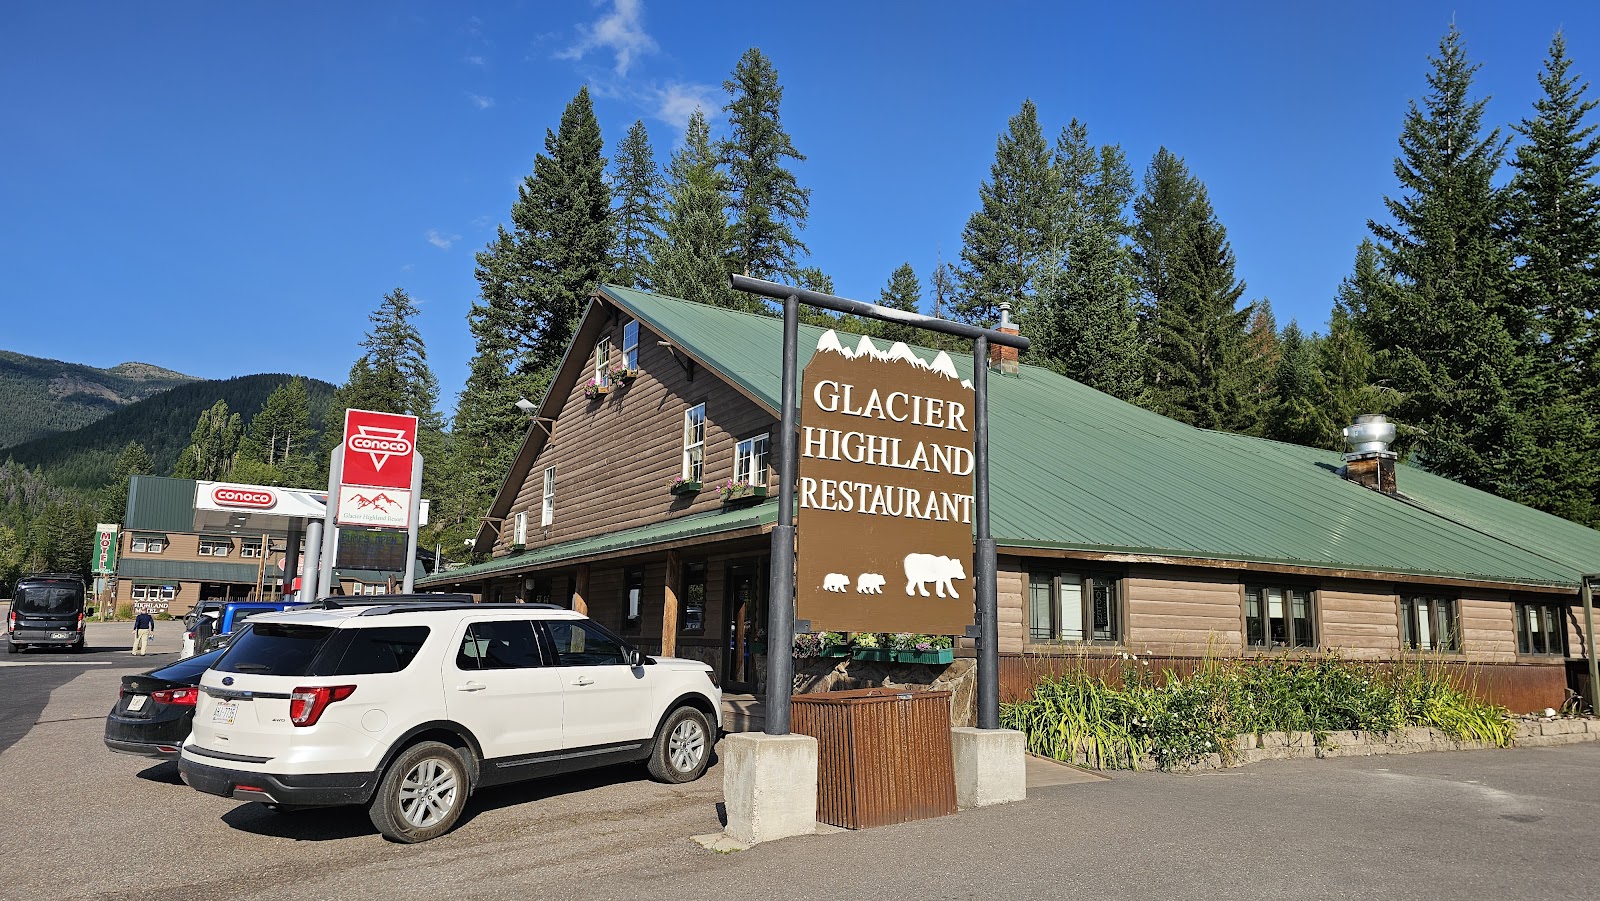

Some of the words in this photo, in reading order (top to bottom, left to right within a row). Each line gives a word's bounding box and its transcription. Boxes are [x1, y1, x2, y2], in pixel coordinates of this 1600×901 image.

[813, 380, 969, 432] GLACIER
[802, 426, 975, 476] HIGHLAND
[363, 513, 387, 521] Highland
[800, 477, 975, 524] RESTAURANT
[99, 532, 111, 570] MOTEL
[375, 535, 397, 545] OPEN
